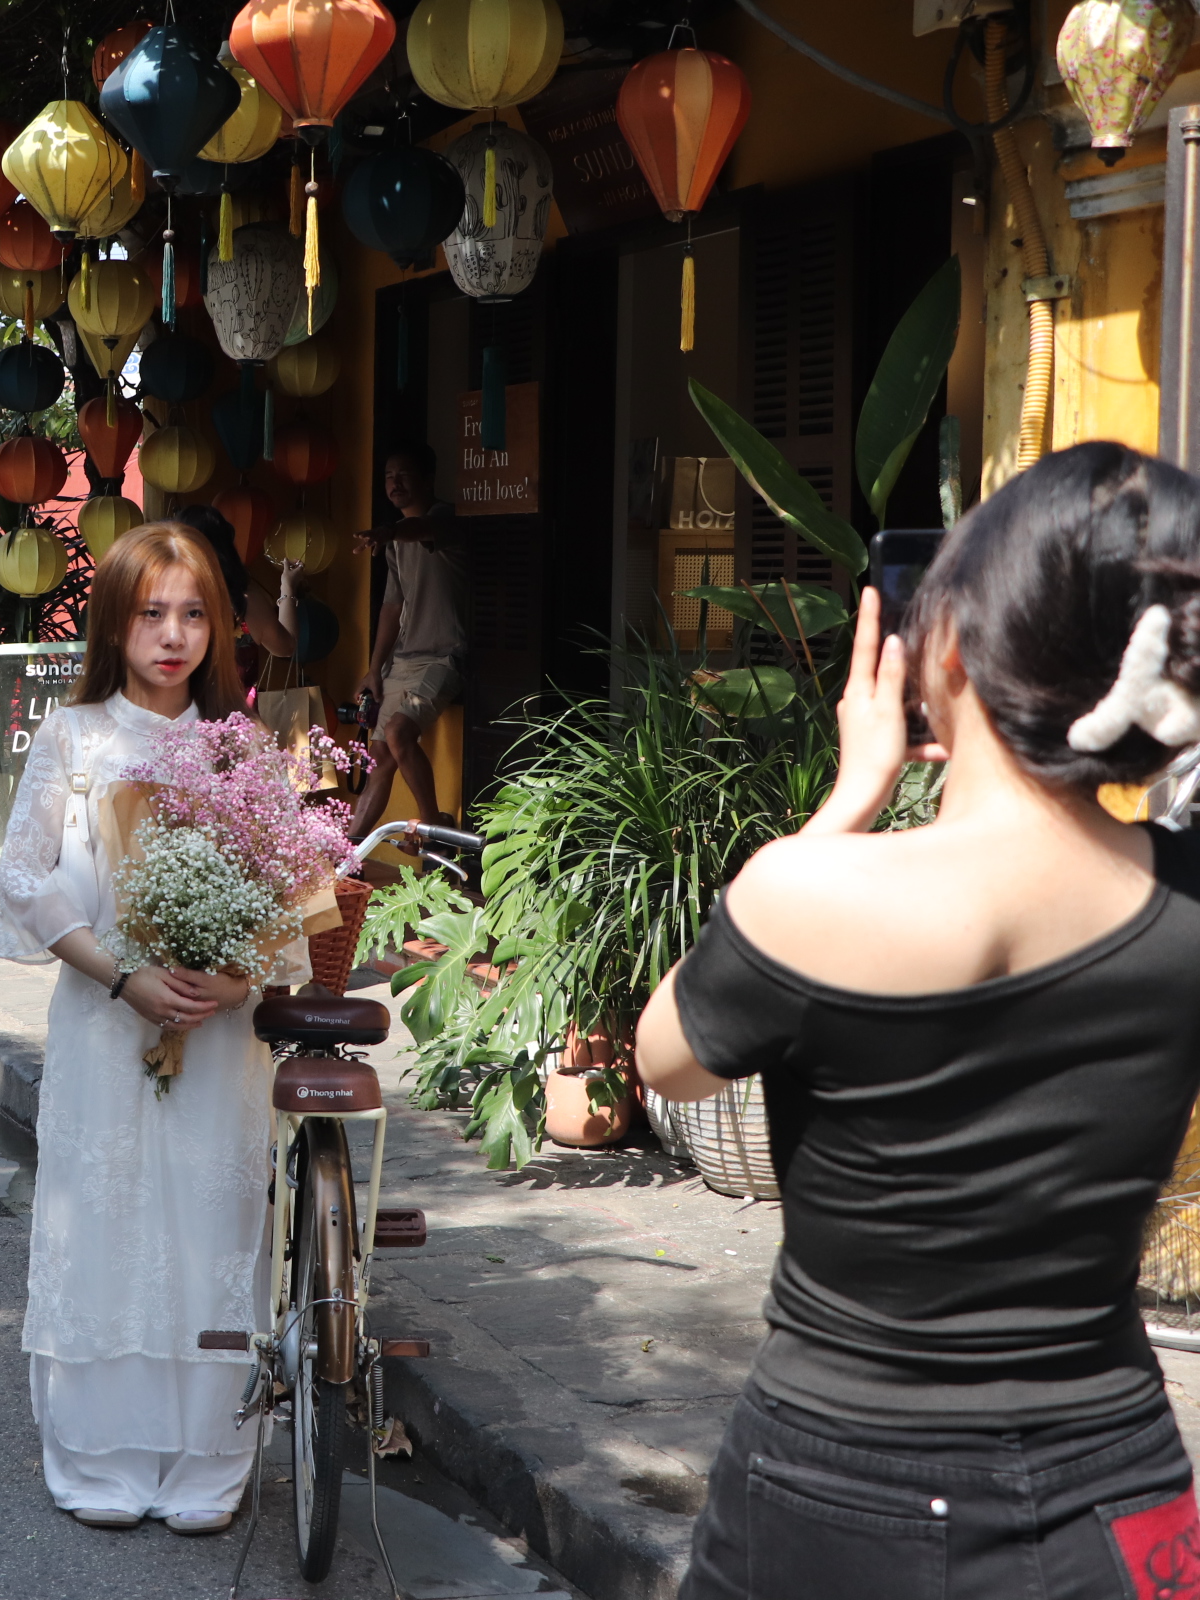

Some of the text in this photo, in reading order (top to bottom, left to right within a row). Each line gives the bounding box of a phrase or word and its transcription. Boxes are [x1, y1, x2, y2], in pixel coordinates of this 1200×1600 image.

[573, 141, 635, 184] SUND
[464, 415, 483, 437] Fr
[463, 447, 509, 470] Hoi An
[462, 476, 529, 502] with love!
[25, 659, 86, 677] sunda
